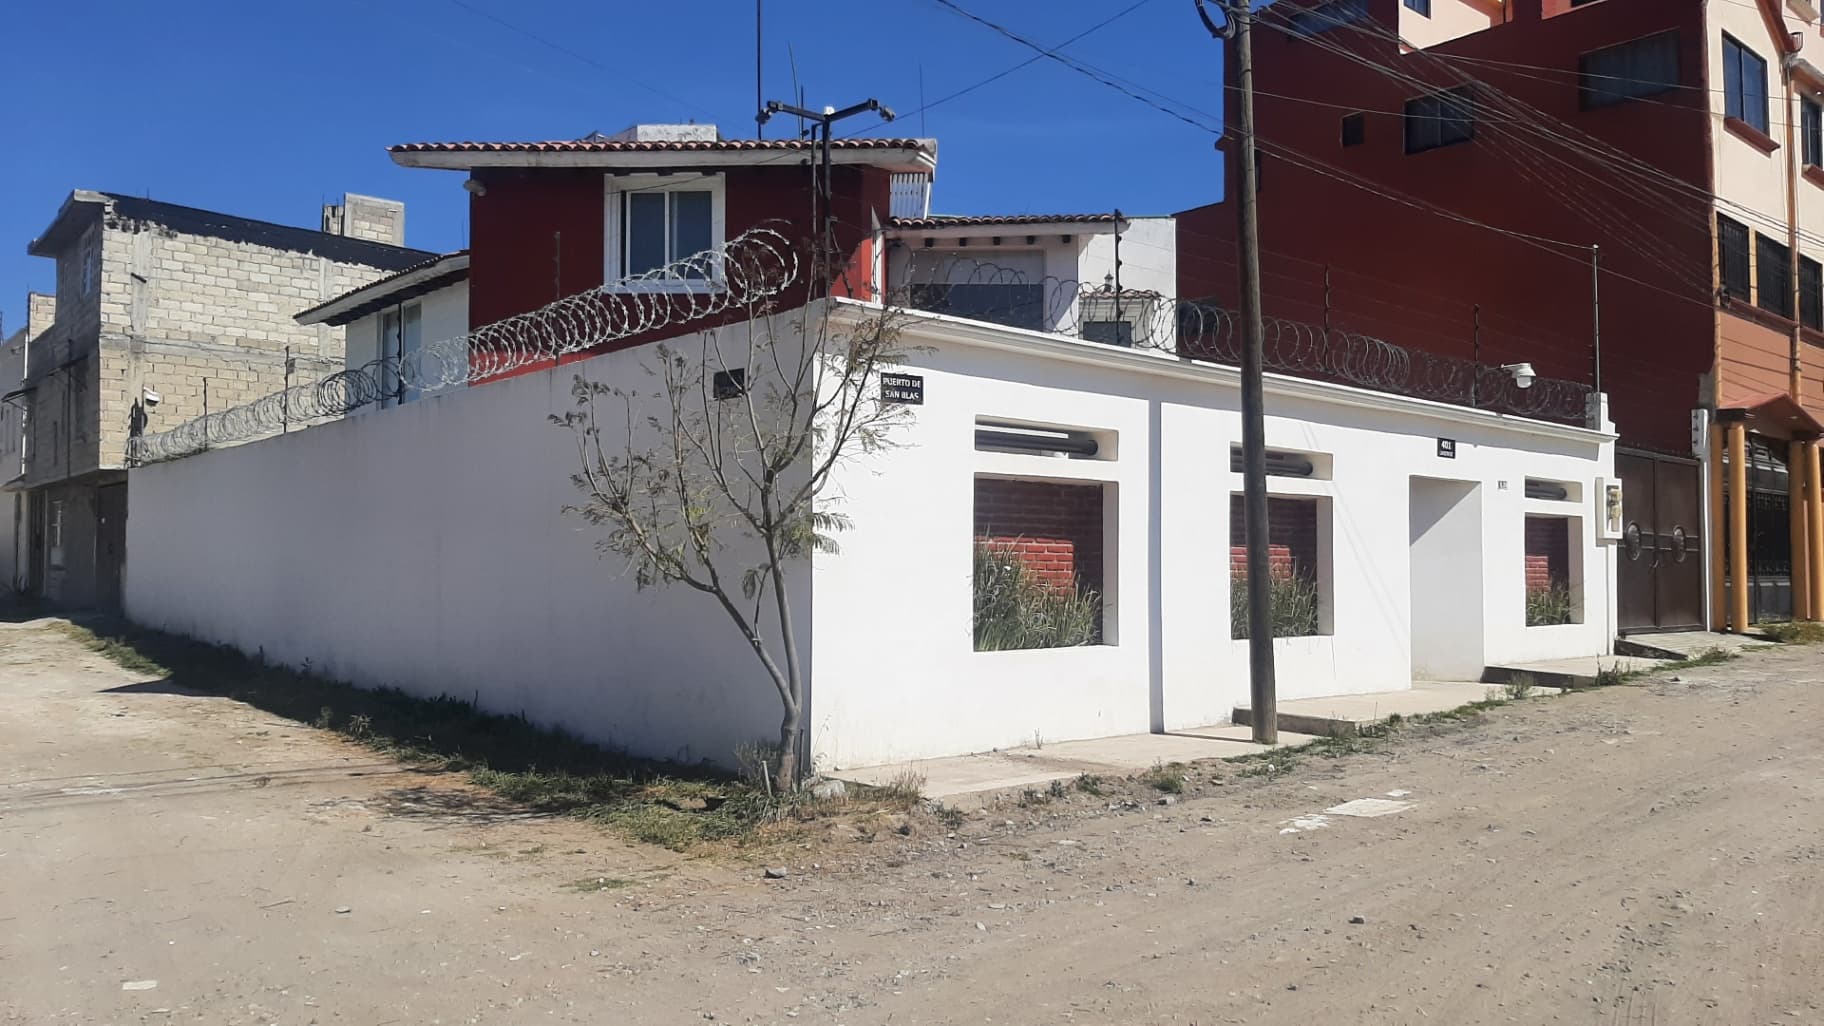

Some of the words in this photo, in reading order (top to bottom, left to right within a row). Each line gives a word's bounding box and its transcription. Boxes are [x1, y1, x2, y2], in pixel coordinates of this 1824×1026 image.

[882, 377, 910, 387] PUERTO
[911, 379, 921, 388] DE
[885, 390, 900, 399] SAN
[901, 391, 919, 400] BLAS
[1441, 440, 1451, 450] 401
